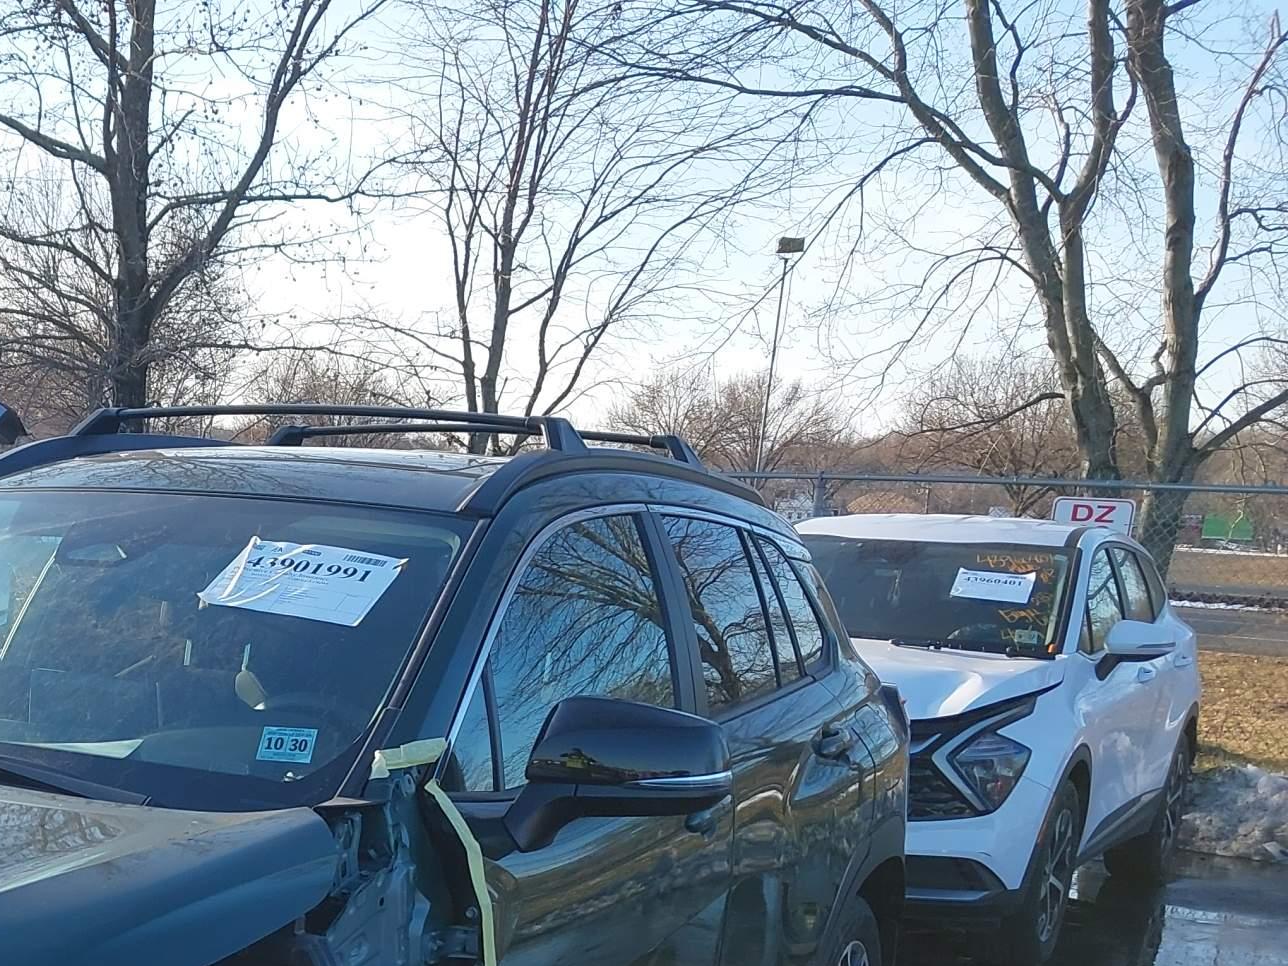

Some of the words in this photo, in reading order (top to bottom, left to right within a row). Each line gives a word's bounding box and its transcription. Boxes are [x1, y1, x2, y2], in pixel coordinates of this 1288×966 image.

[1071, 503, 1116, 523] DZ
[247, 556, 372, 582] 43901991
[964, 575, 1024, 587] 43960401
[265, 737, 284, 751] 10
[288, 738, 308, 752] 30
